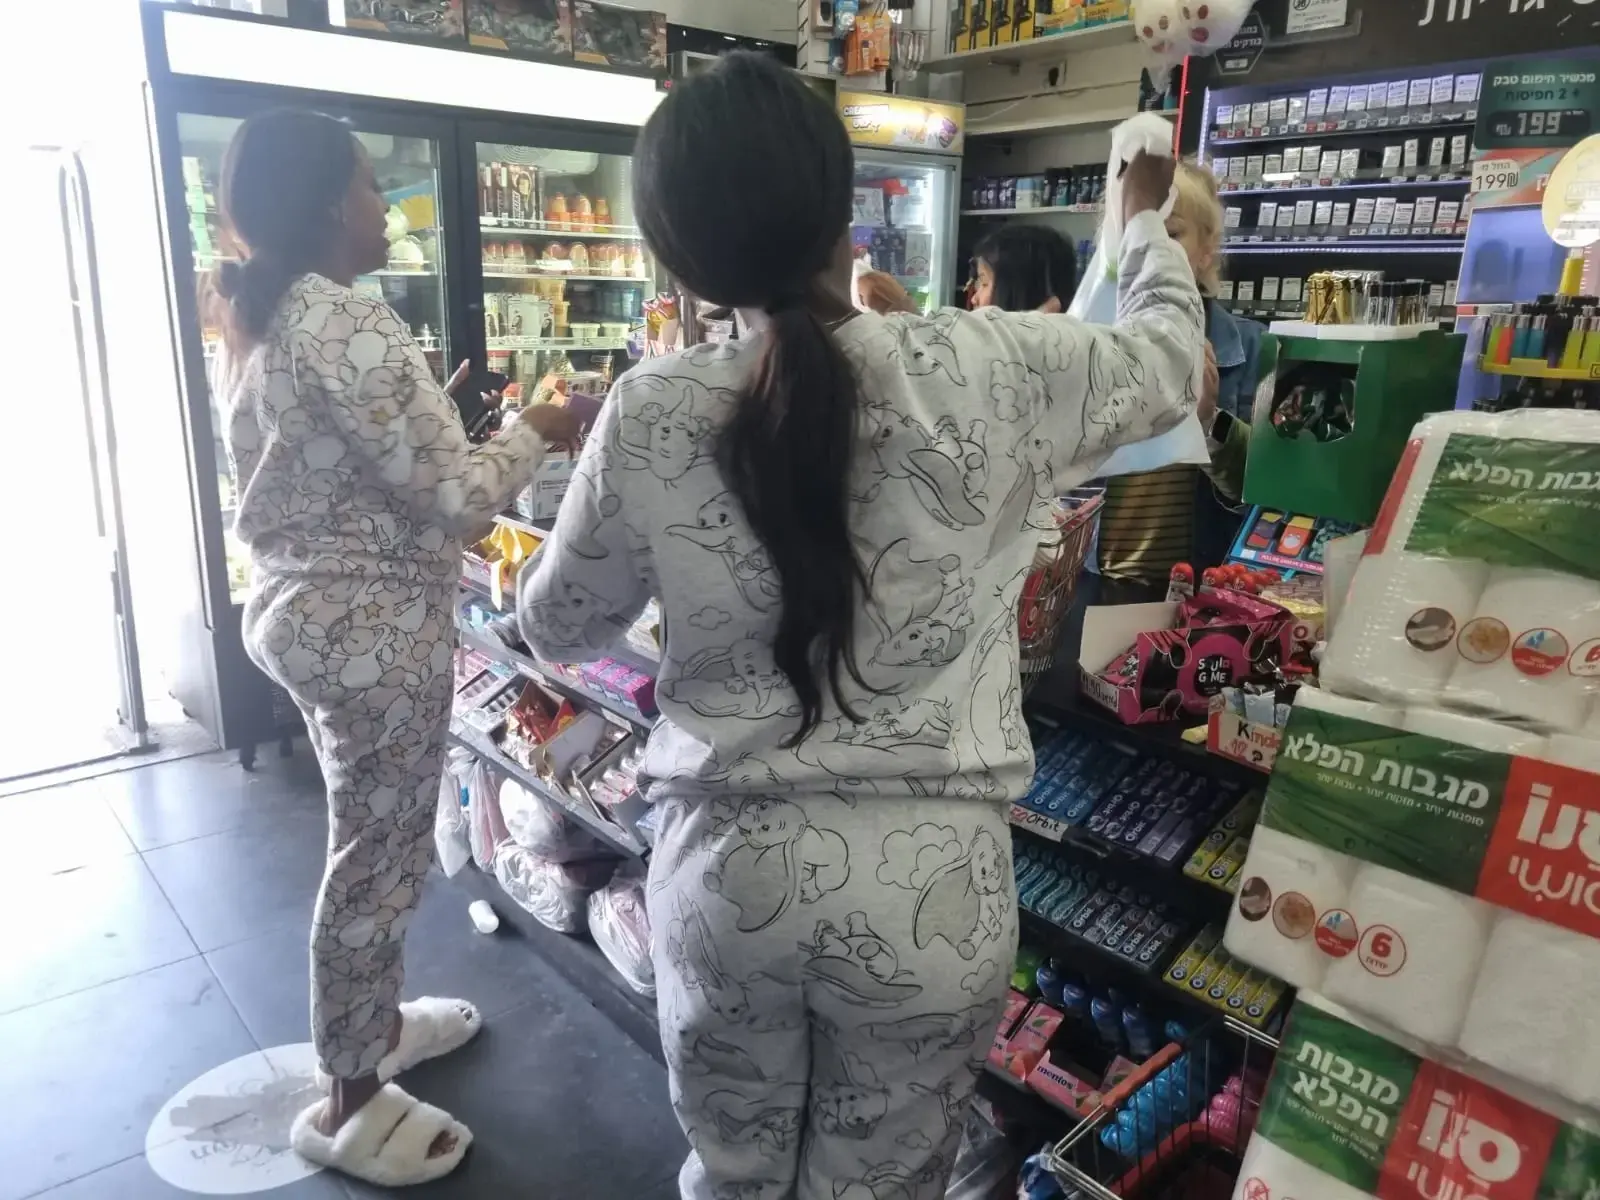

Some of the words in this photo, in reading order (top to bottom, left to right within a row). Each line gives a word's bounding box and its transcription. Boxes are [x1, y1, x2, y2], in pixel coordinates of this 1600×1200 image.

[1492, 75, 1519, 88] טבק
[1521, 74, 1556, 85] חימום
[1559, 72, 1597, 84] מכשיר
[1558, 87, 1567, 99] 2
[1517, 111, 1562, 136] 199
[1450, 458, 1534, 489] הפלא
[1283, 732, 1366, 776] הפלא
[1372, 757, 1490, 810] מגבות
[1027, 812, 1060, 832] Orbit
[1371, 931, 1393, 958] 6
[1036, 1065, 1074, 1090] mentos
[1296, 1040, 1400, 1105] מגבות
[1292, 1070, 1391, 1138] הפלא
